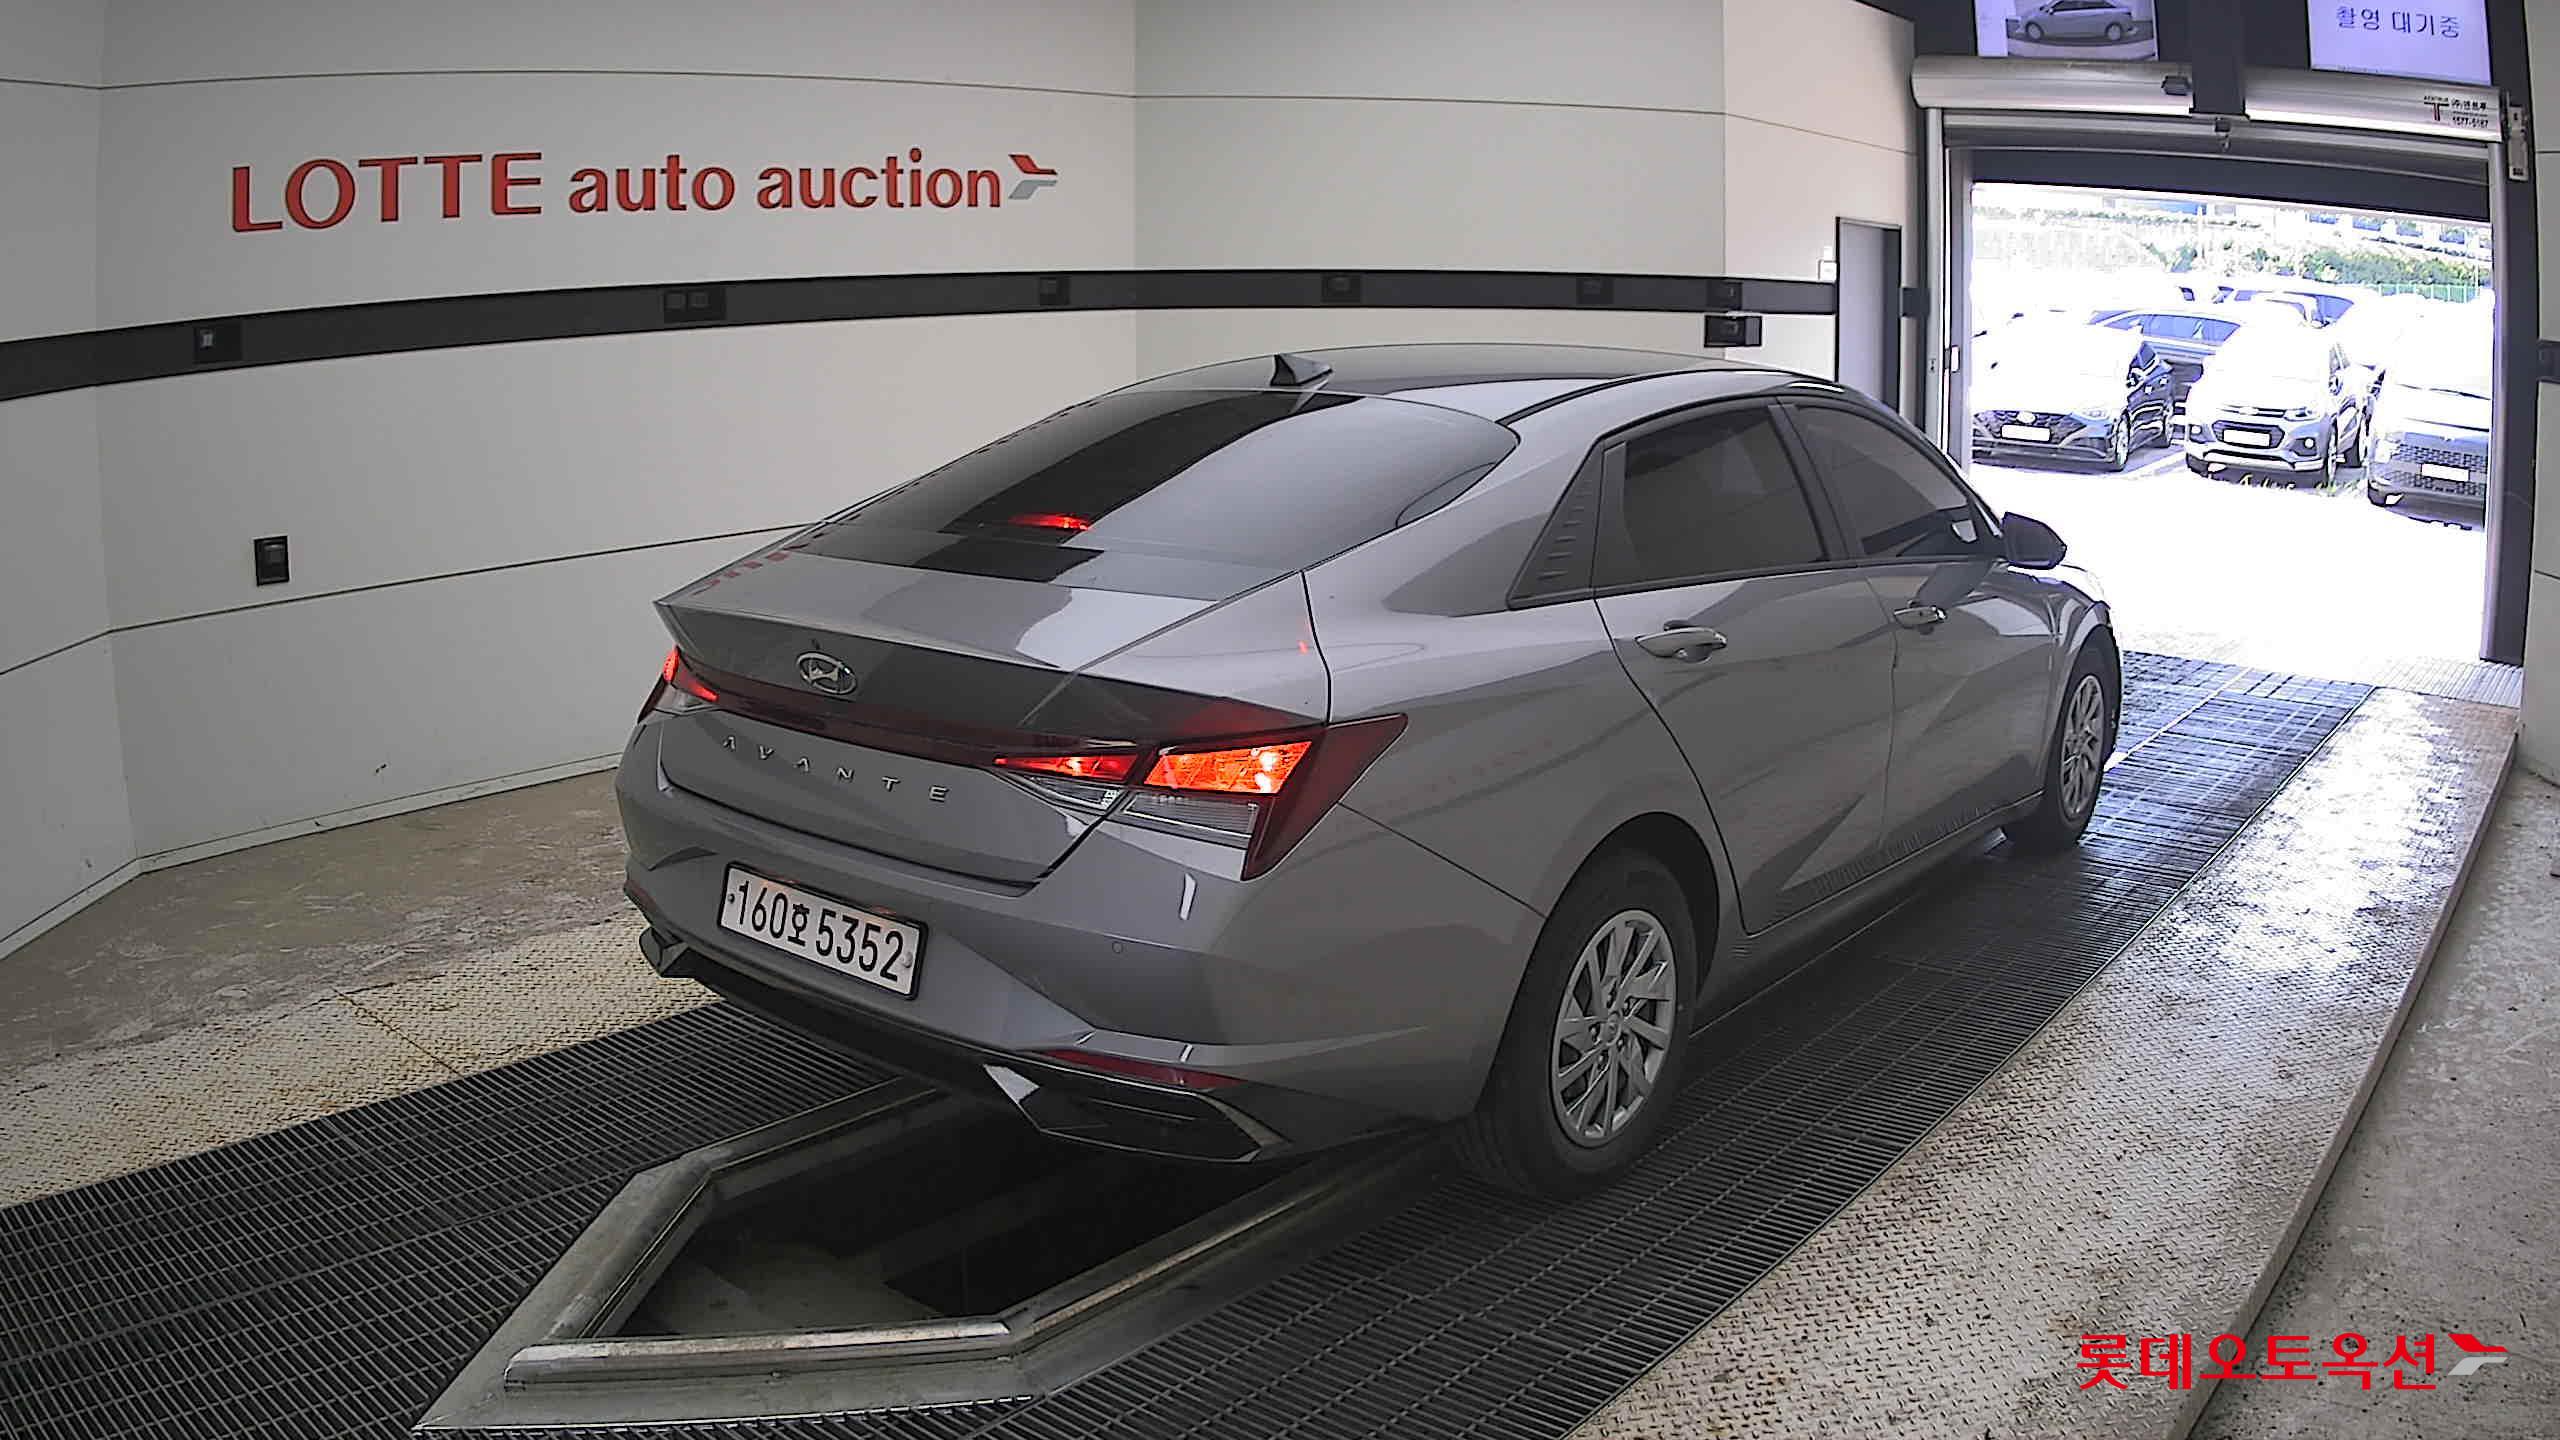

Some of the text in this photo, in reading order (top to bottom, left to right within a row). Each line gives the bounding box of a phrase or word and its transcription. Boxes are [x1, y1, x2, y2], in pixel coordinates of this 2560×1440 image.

[2337, 6, 2460, 38] 촬영 대기중
[232, 147, 1001, 232] LOTTE auto auction
[723, 736, 949, 803] AVANTE
